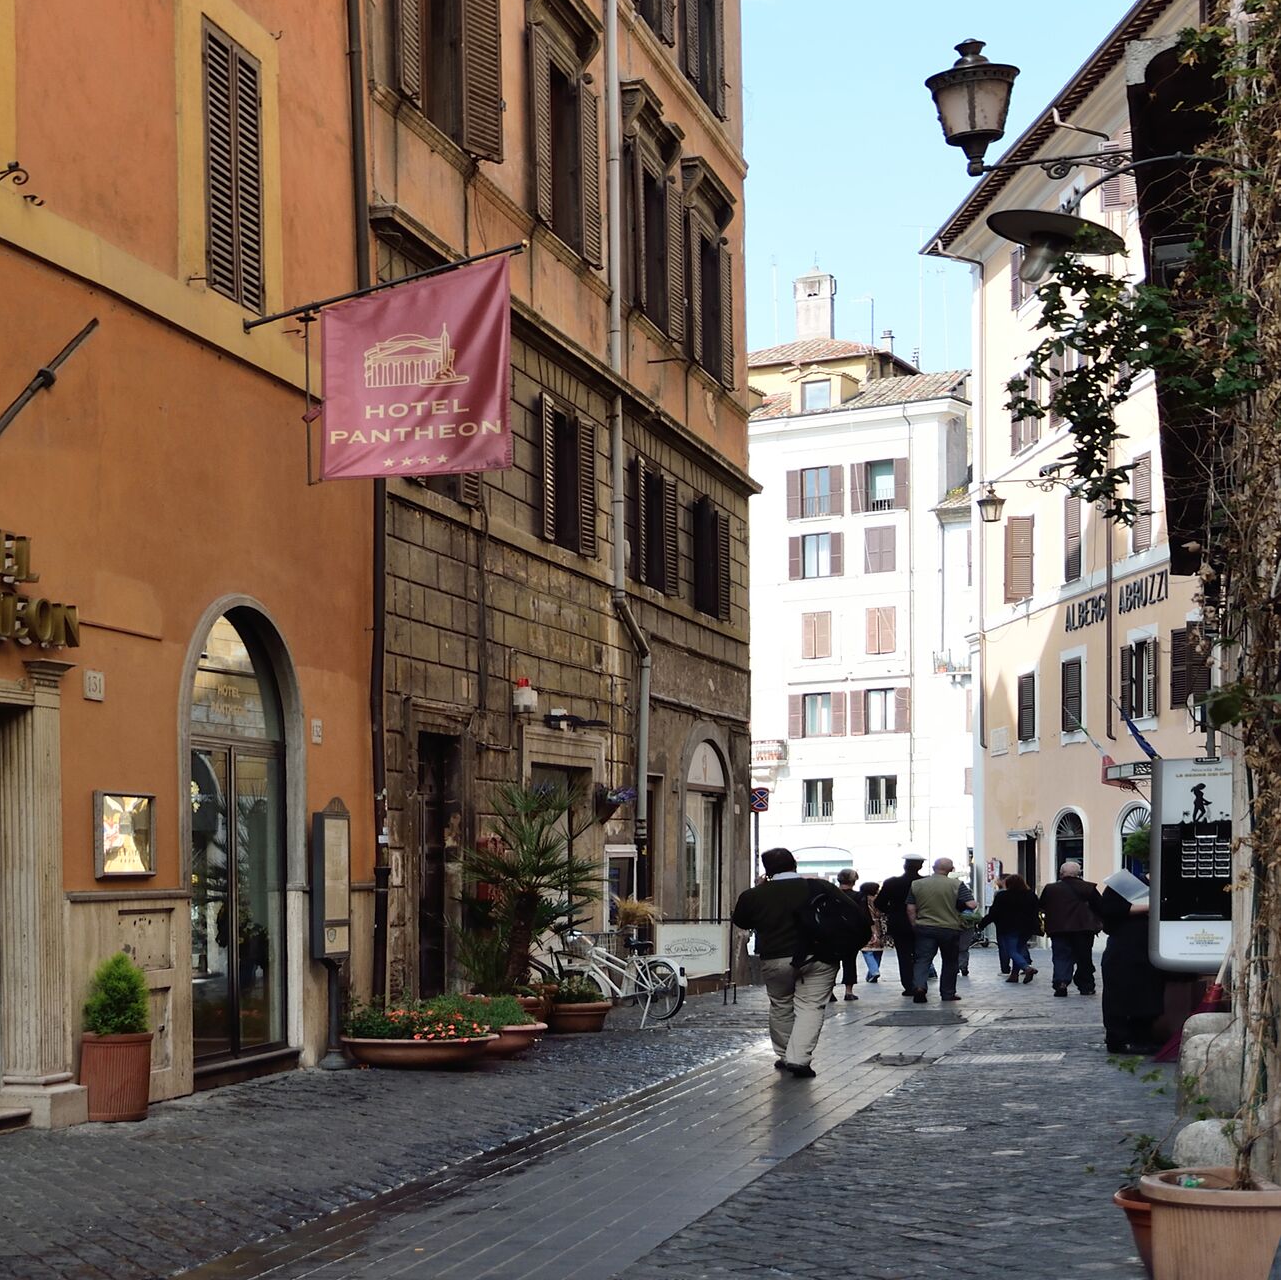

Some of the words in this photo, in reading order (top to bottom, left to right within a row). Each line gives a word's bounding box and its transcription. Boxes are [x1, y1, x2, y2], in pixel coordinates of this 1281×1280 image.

[365, 399, 469, 420] HOTEL
[329, 419, 502, 445] PANTHEON
[1065, 592, 1110, 633] ALBERG
[1118, 569, 1168, 615] ABRUZZI
[88, 675, 102, 695] 131
[217, 684, 241, 698] HOTEL
